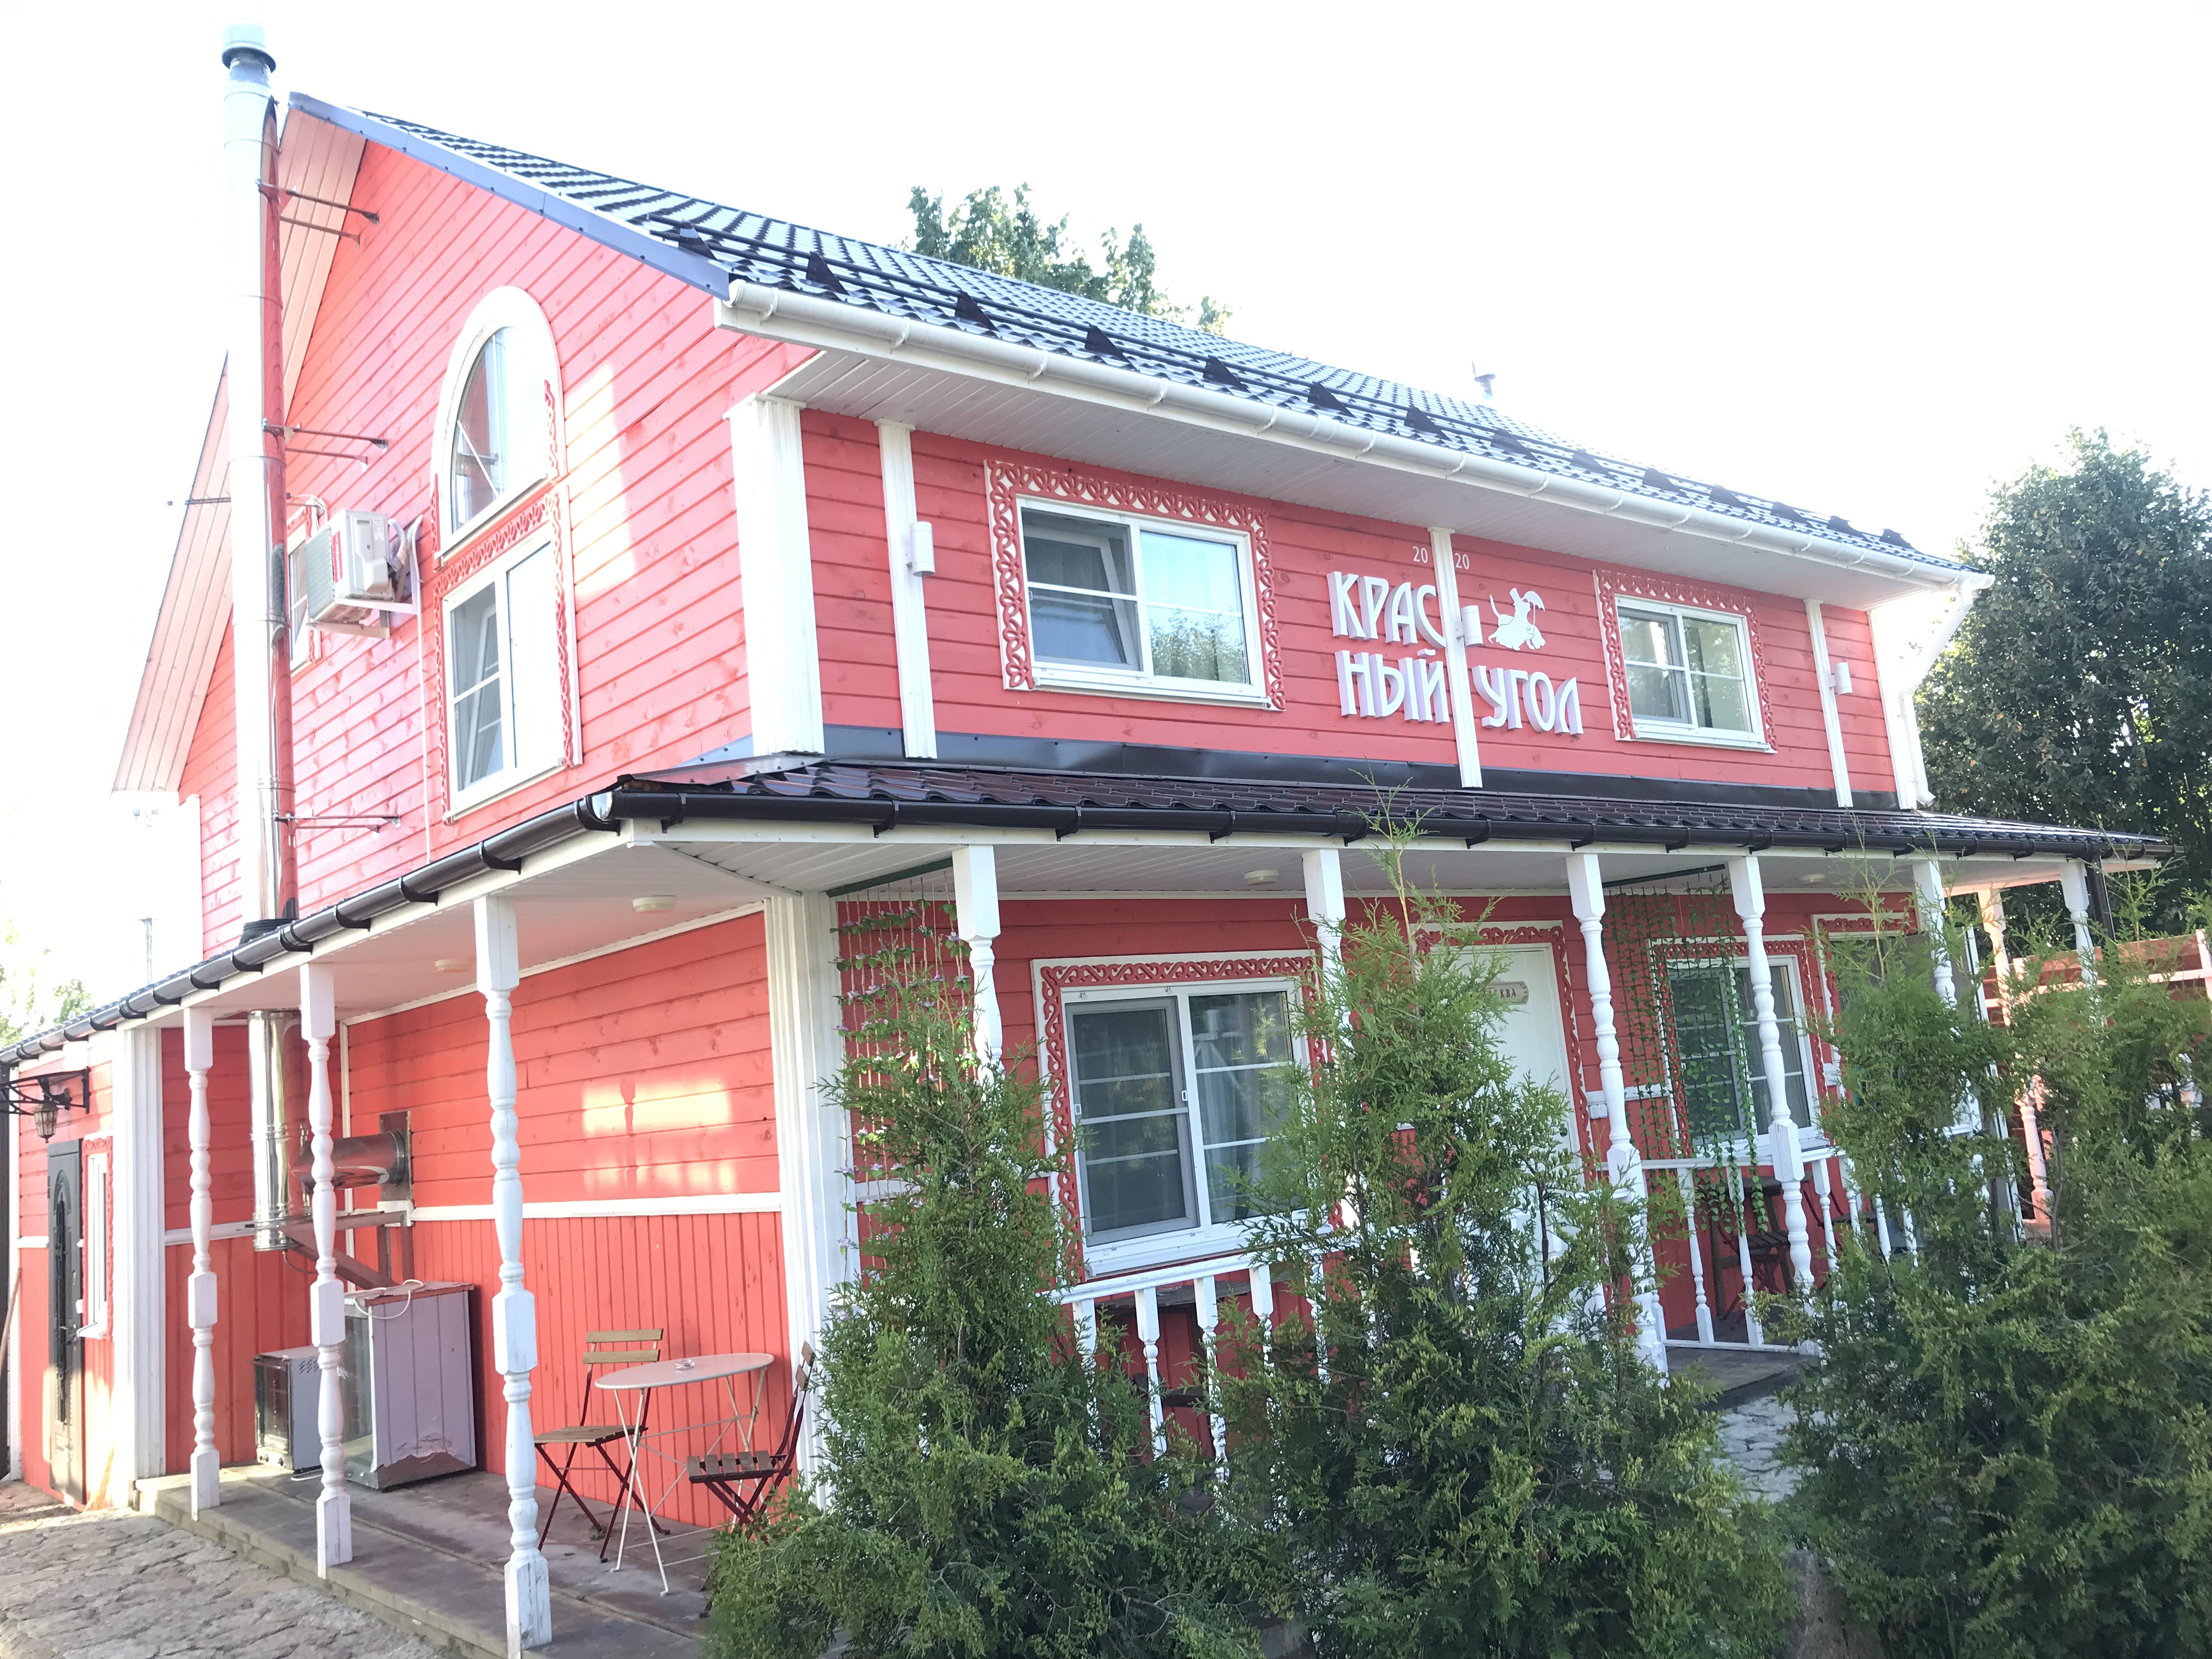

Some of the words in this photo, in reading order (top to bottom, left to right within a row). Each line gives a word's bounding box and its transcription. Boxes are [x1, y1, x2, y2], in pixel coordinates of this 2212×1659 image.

[1412, 546, 1428, 564] 20
[1454, 552, 1470, 570] 20
[1326, 571, 1447, 648] КРАС
[1334, 648, 1451, 724] НЫЙ
[1472, 665, 1584, 735] УГОЛ
